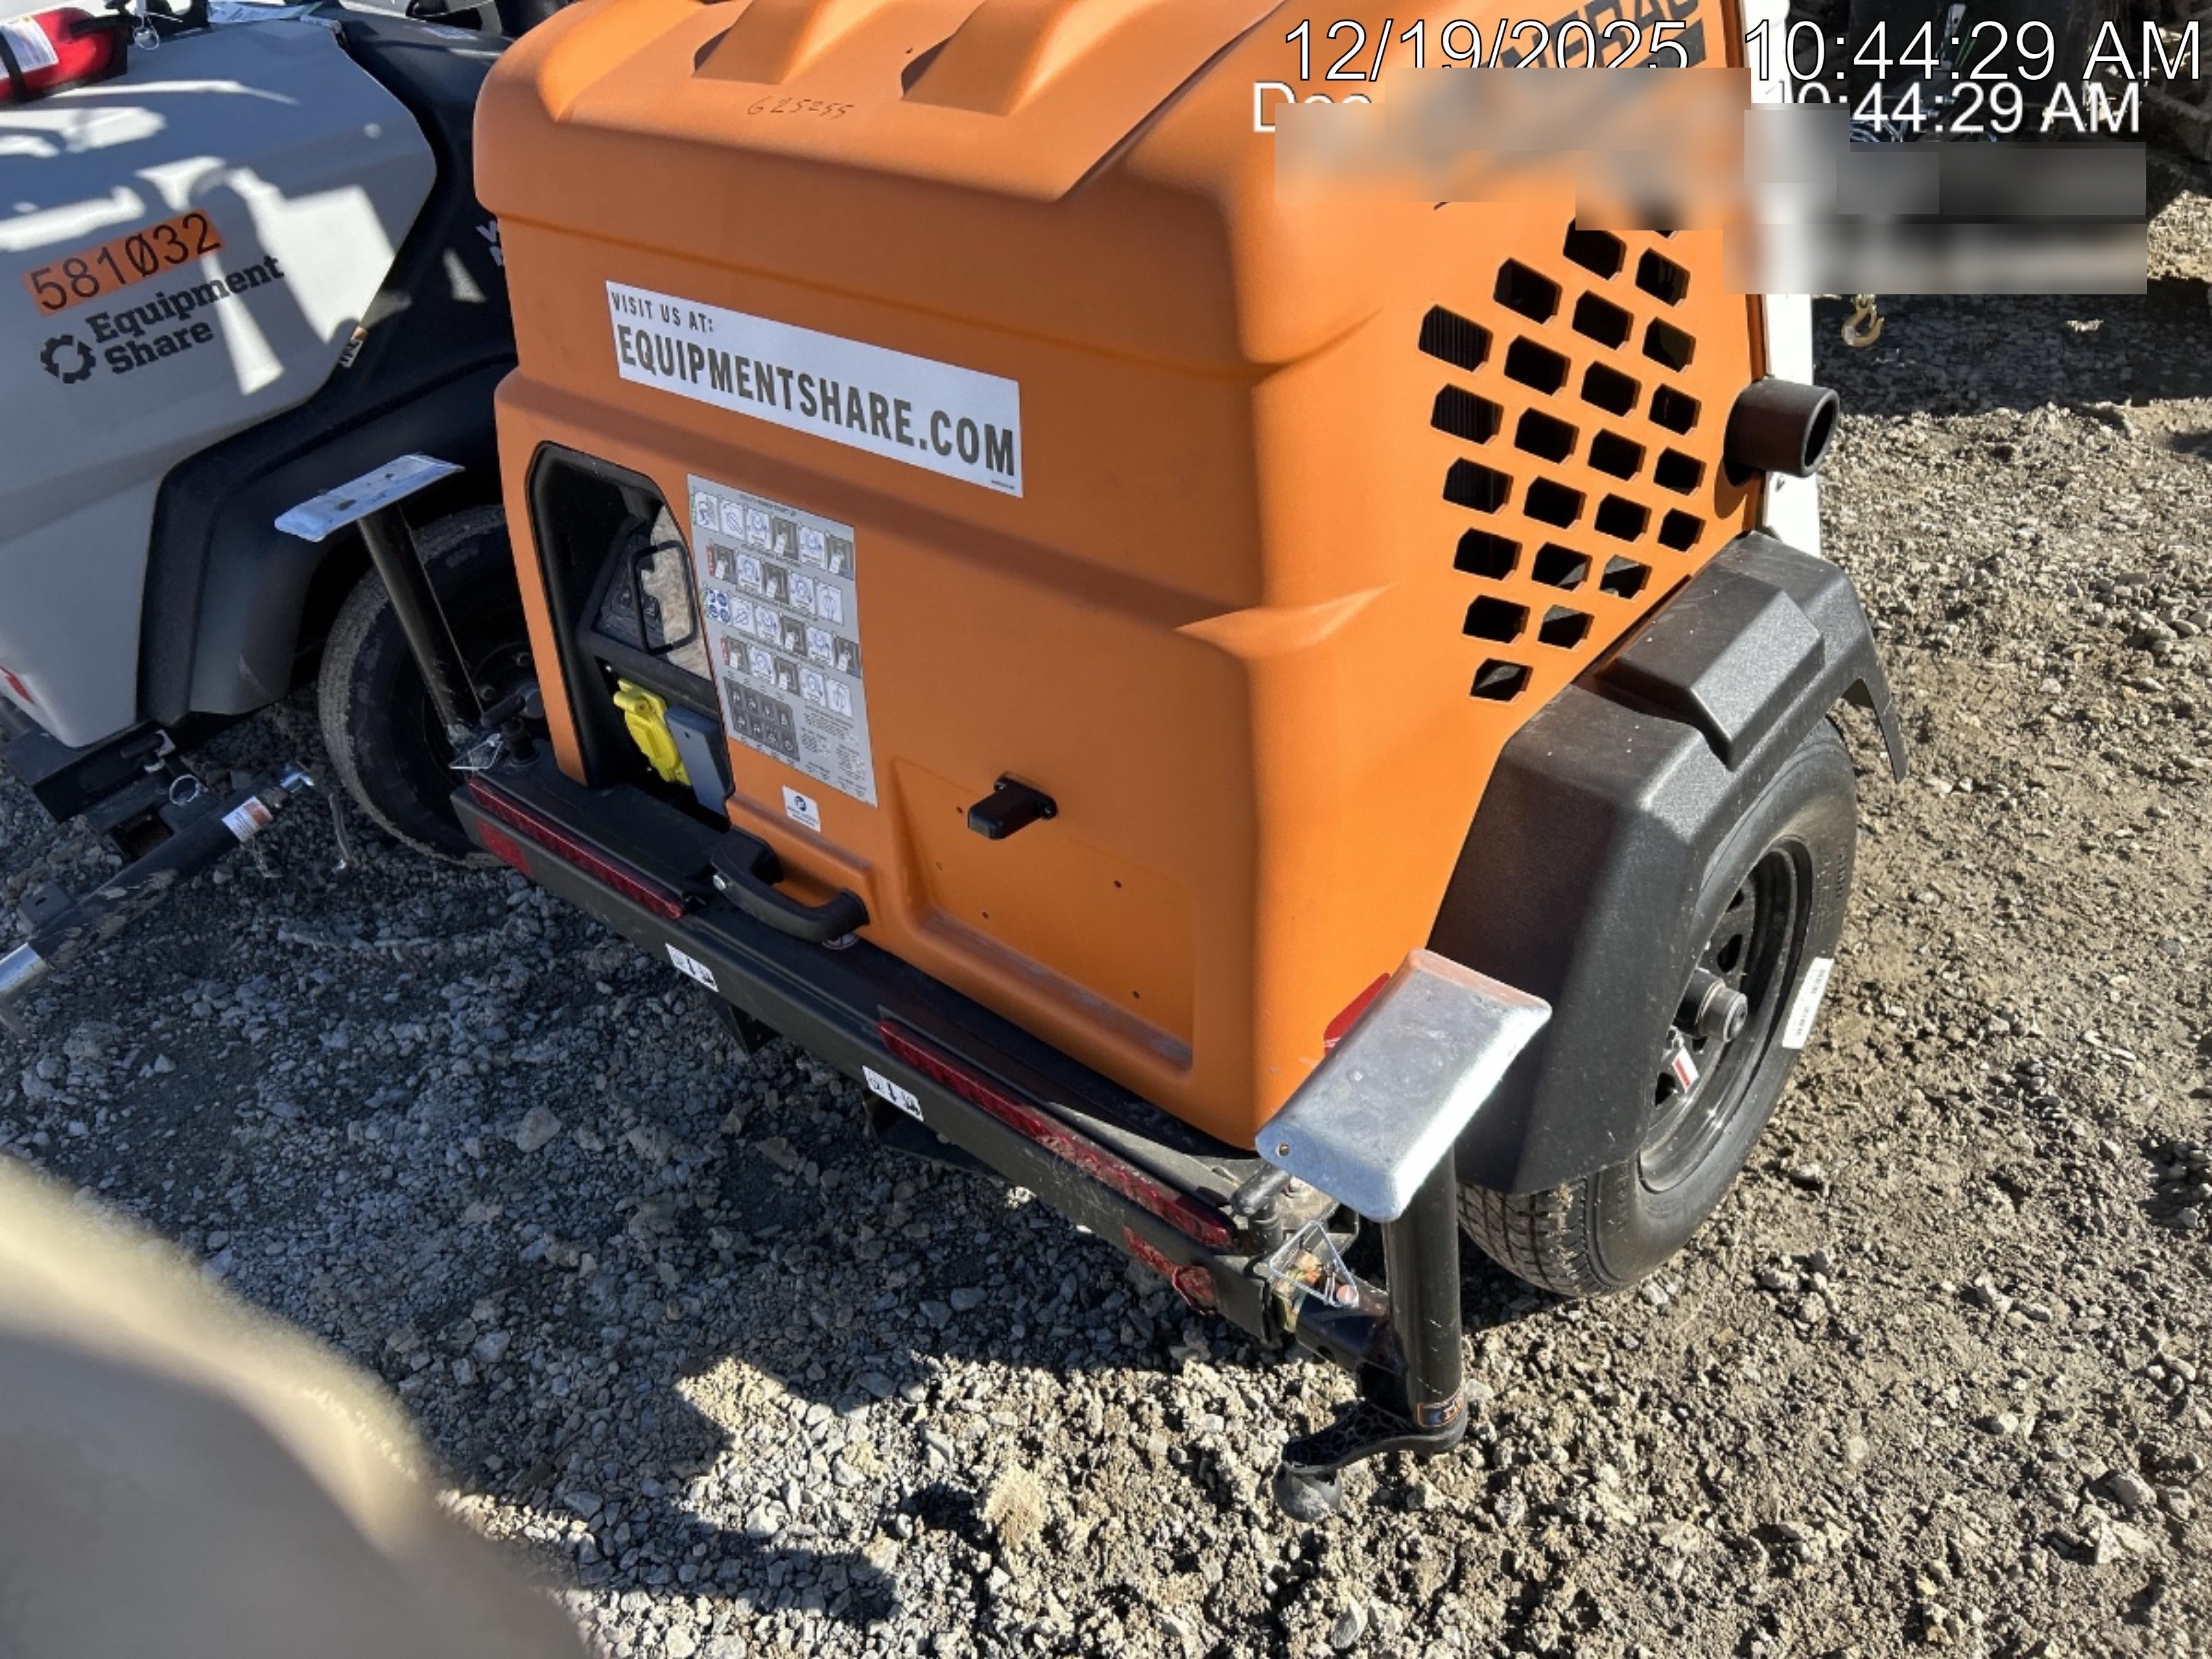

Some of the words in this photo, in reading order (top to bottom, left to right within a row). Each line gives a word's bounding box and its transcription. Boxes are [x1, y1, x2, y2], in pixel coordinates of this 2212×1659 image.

[85, 255, 284, 343] Equipment
[611, 292, 653, 320] VISIT
[660, 304, 681, 327] US
[688, 310, 714, 334] AT:
[104, 321, 215, 375] Share
[618, 324, 1015, 477] EQUIPMENTSHARE.COM
